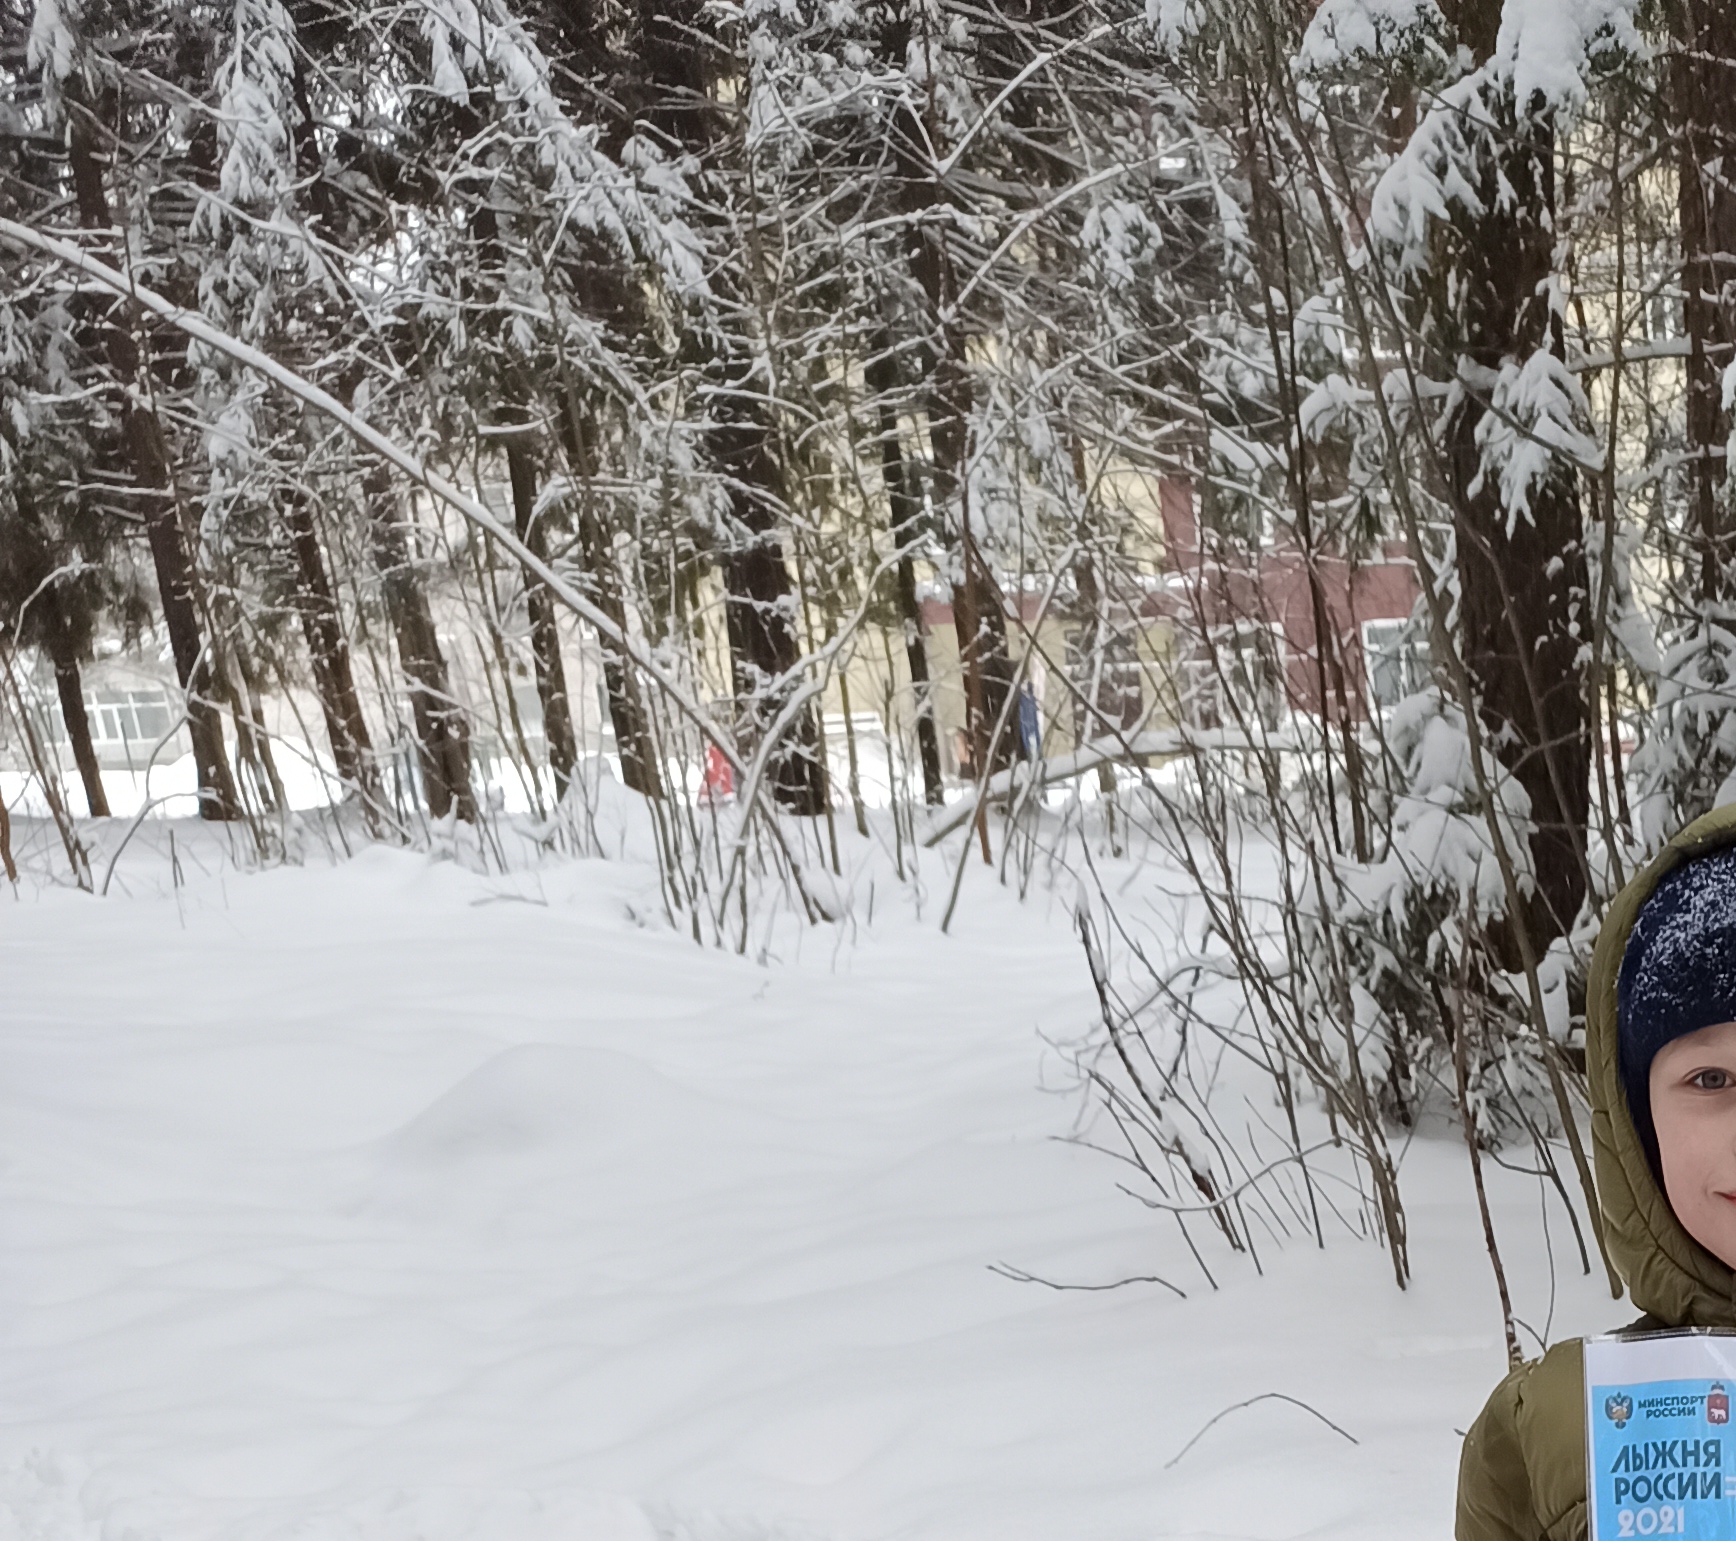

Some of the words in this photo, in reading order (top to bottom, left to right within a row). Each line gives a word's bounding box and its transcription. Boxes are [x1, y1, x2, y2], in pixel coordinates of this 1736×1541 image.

[1638, 1395, 1706, 1409] МИНСПОРТ
[1646, 1406, 1696, 1419] РОССИИ
[1610, 1439, 1721, 1473] ЛЫЖНЯ
[1614, 1471, 1722, 1505] РОССИИ
[1617, 1505, 1685, 1538] 2021
